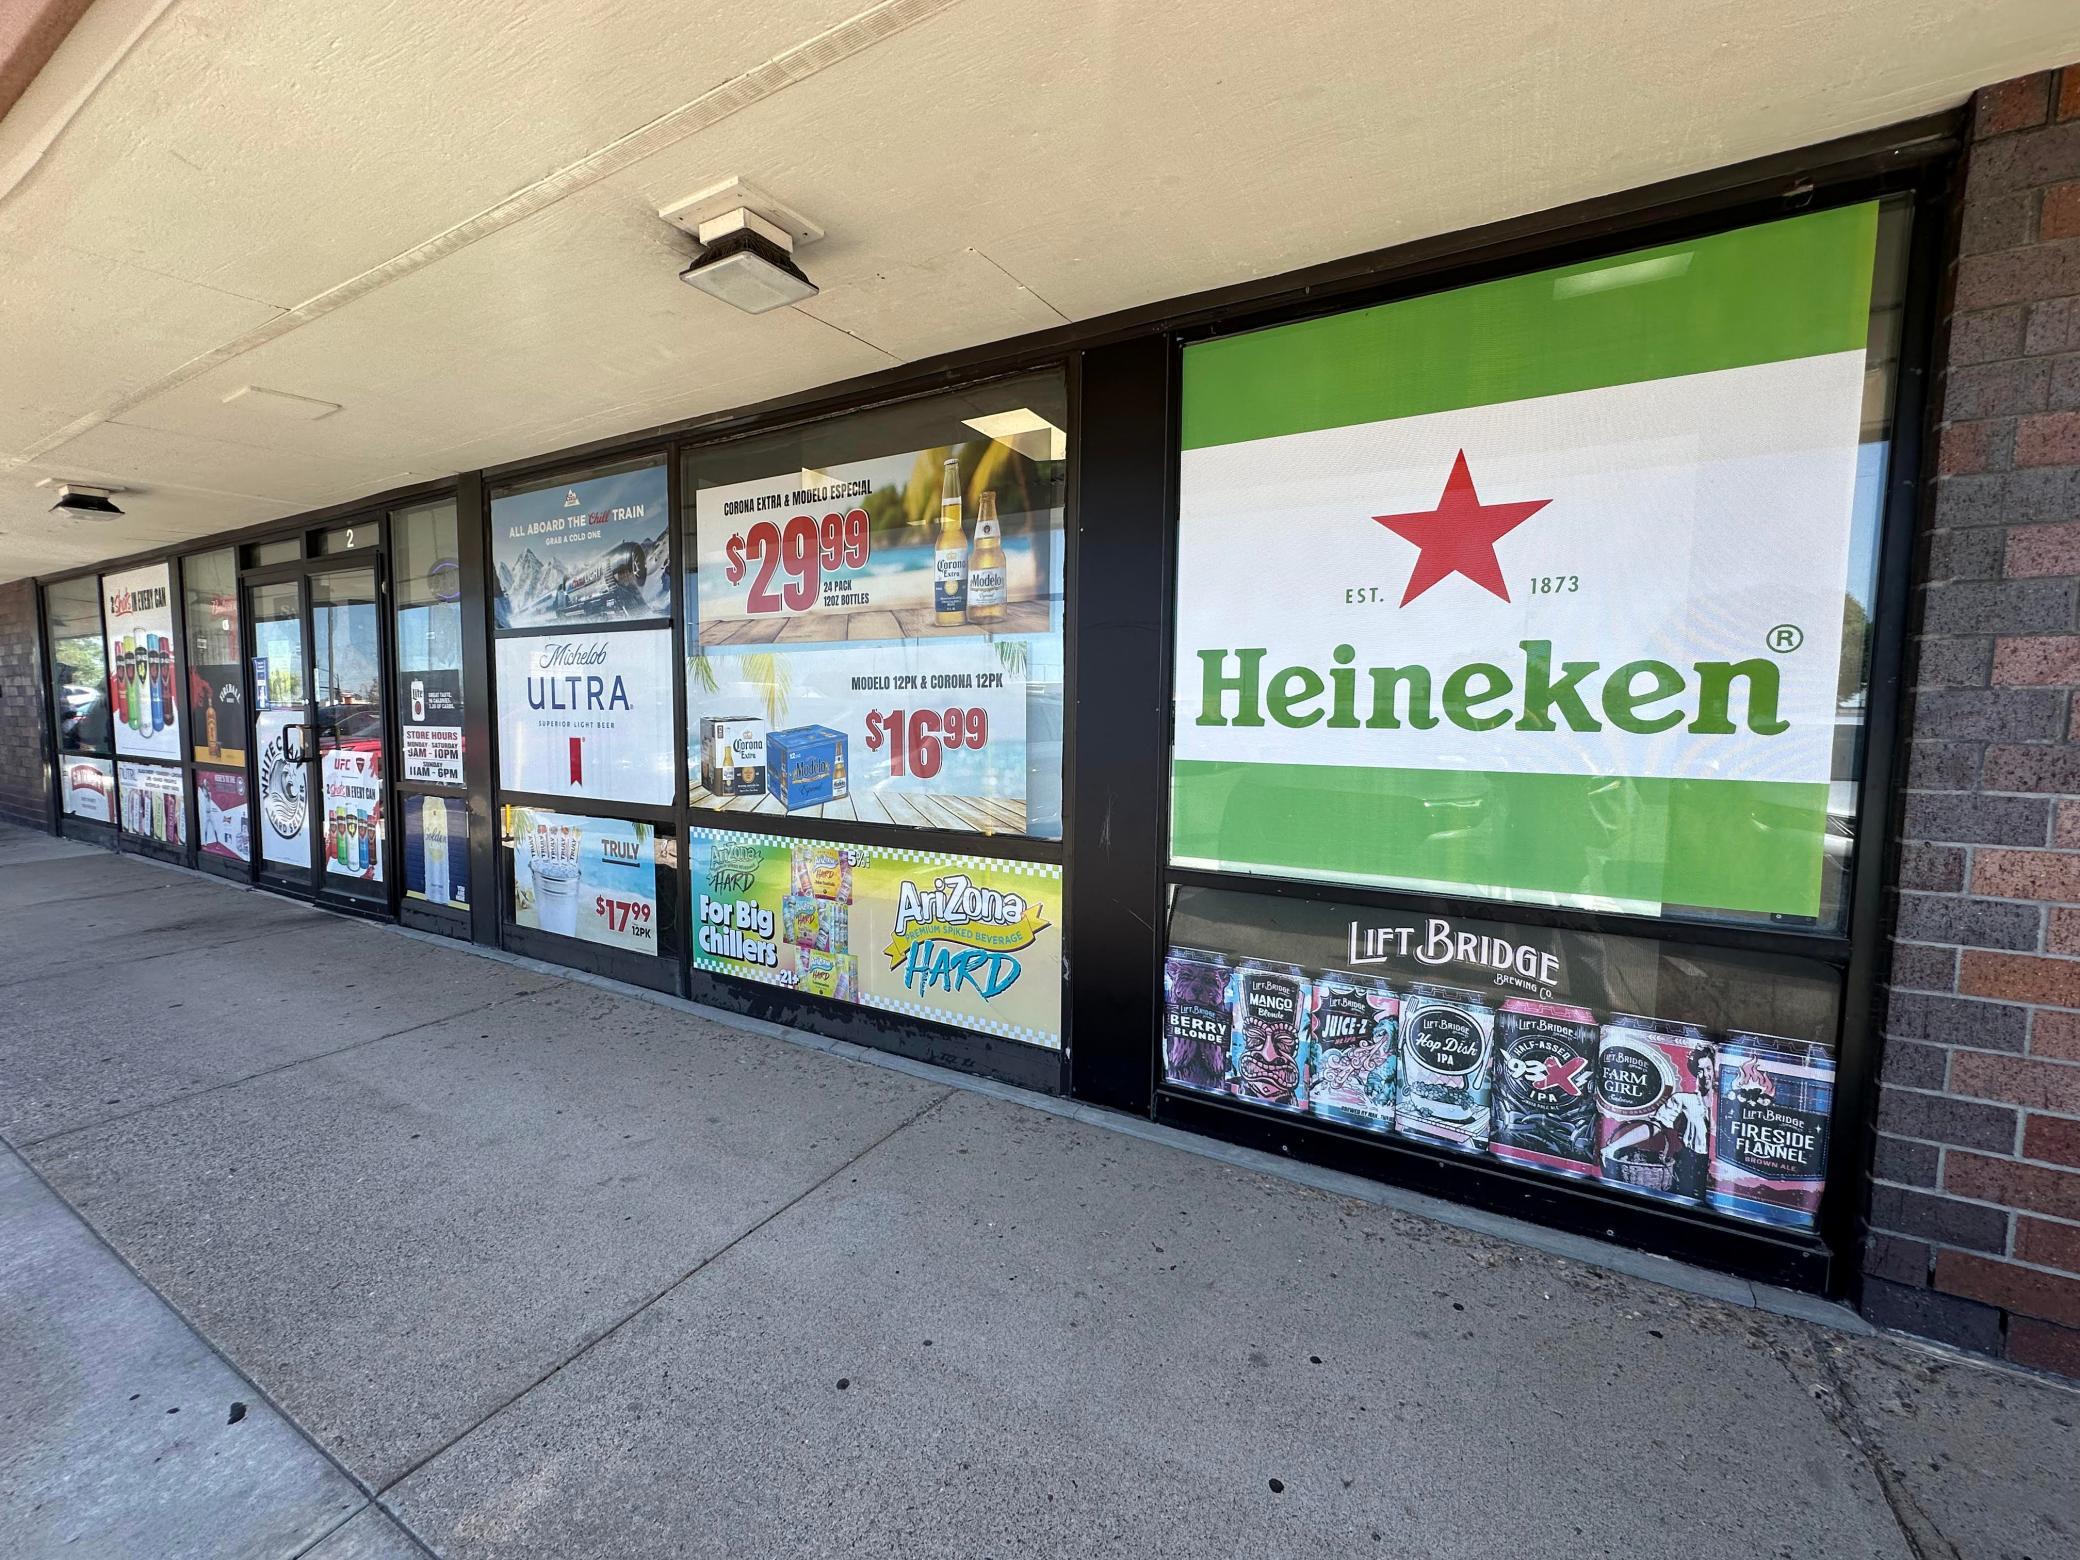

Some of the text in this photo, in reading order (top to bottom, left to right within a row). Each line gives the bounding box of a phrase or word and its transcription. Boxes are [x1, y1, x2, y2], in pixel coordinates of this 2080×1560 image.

[724, 479, 872, 516] CORONA EXTRA & MODELO ESPECIAL
[509, 504, 645, 538] ALL ABOARD THE Chill TRAIN
[346, 529, 354, 548] 2
[545, 537, 563, 546] GRAB
[569, 533, 586, 541] COLD
[587, 531, 601, 539] ONE
[937, 559, 966, 572] Corona
[943, 570, 960, 578] Extra
[824, 580, 852, 593] 24 PACK
[972, 573, 1002, 587] Modelo
[1344, 575, 1580, 604] EST. 1873
[841, 593, 870, 605] BOTTLES
[539, 641, 609, 669] Michelob
[852, 673, 1003, 690] MODELO 12PK & CORONA 12PK
[1195, 640, 1791, 737] Heineken
[527, 675, 630, 711] ULTRA
[538, 720, 570, 728] SUPERIOR
[406, 730, 458, 740] STORE HOURS
[434, 749, 458, 759] 10PM
[733, 739, 762, 752] Corona
[741, 751, 756, 759] Extra
[262, 740, 276, 800] WHITE
[334, 758, 351, 770] UFC
[409, 767, 458, 778] 11AM 6PM
[796, 759, 826, 777] Modelo
[365, 788, 376, 800] CAN
[602, 839, 640, 860] TRULY
[714, 870, 755, 894] HARD
[894, 874, 1028, 936] AriZona
[699, 895, 774, 940] For Big
[632, 925, 651, 939] 12PK
[904, 925, 1024, 945] PREMIUM SPIKED BEVERAGE
[699, 926, 778, 967] Chillers
[780, 970, 800, 986] 21+
[904, 939, 1022, 1003] HARD
[1494, 973, 1537, 993] BREWING
[1250, 993, 1293, 1012] MANGO
[1258, 1008, 1284, 1020] Blonde
[1170, 1014, 1227, 1036] BERRY
[1321, 1014, 1368, 1038] JUICE-Z
[1174, 1027, 1223, 1044] BLONDE
[1416, 1032, 1478, 1056] Hop Dish
[1437, 1053, 1454, 1066] IPA
[1514, 1040, 1572, 1061] HALF-ASSED
[1505, 1055, 1589, 1096] 93X
[1602, 1067, 1647, 1086] FARM
[1530, 1090, 1558, 1102] IPA
[1604, 1080, 1642, 1097] GIRL
[1730, 1121, 1815, 1150] FIRESIDE
[1736, 1137, 1808, 1164] FLANNEL
[1744, 1156, 1797, 1172] BROWN ALE
